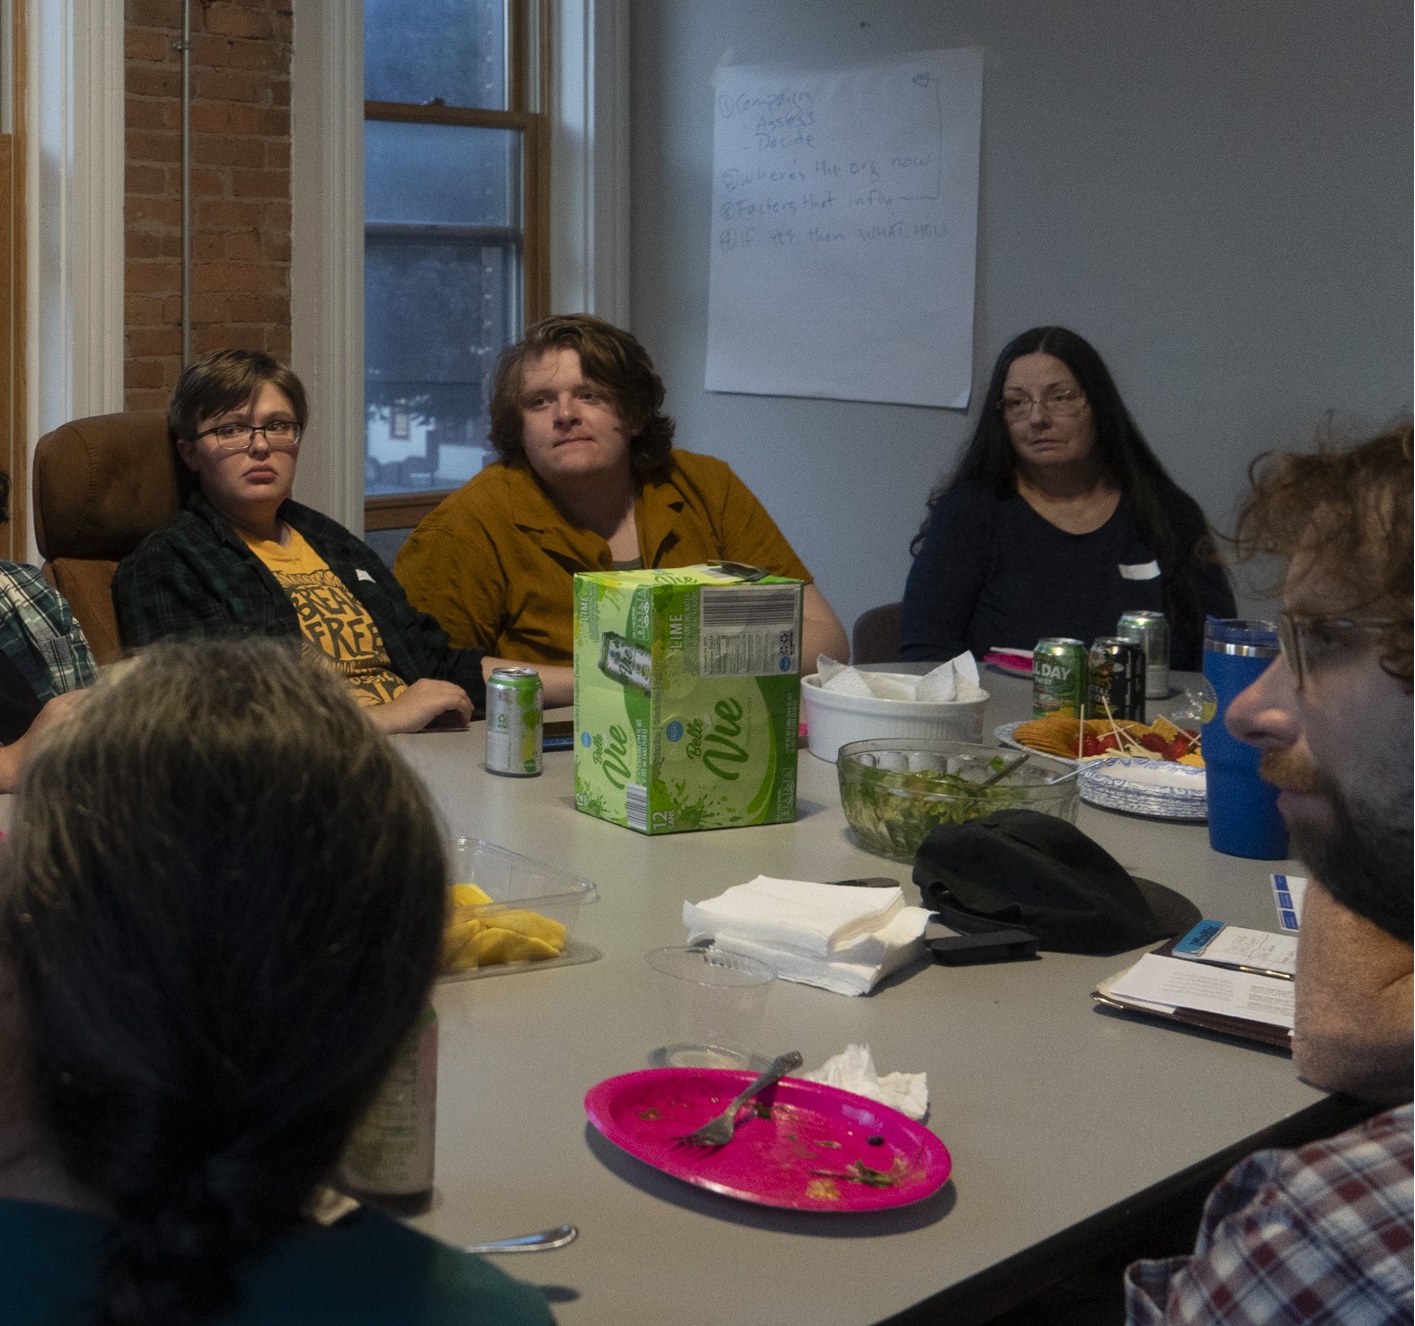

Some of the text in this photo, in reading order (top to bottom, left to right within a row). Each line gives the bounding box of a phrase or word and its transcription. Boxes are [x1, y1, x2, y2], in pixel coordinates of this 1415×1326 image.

[580, 595, 589, 621] LIME
[305, 617, 384, 661] FREE
[668, 613, 683, 648] LIME
[1041, 663, 1072, 681] DAY
[592, 734, 603, 765] Belle
[686, 718, 703, 760] Belle
[703, 698, 749, 781] Vie
[602, 724, 631, 790] Vie
[652, 811, 668, 830] 12
